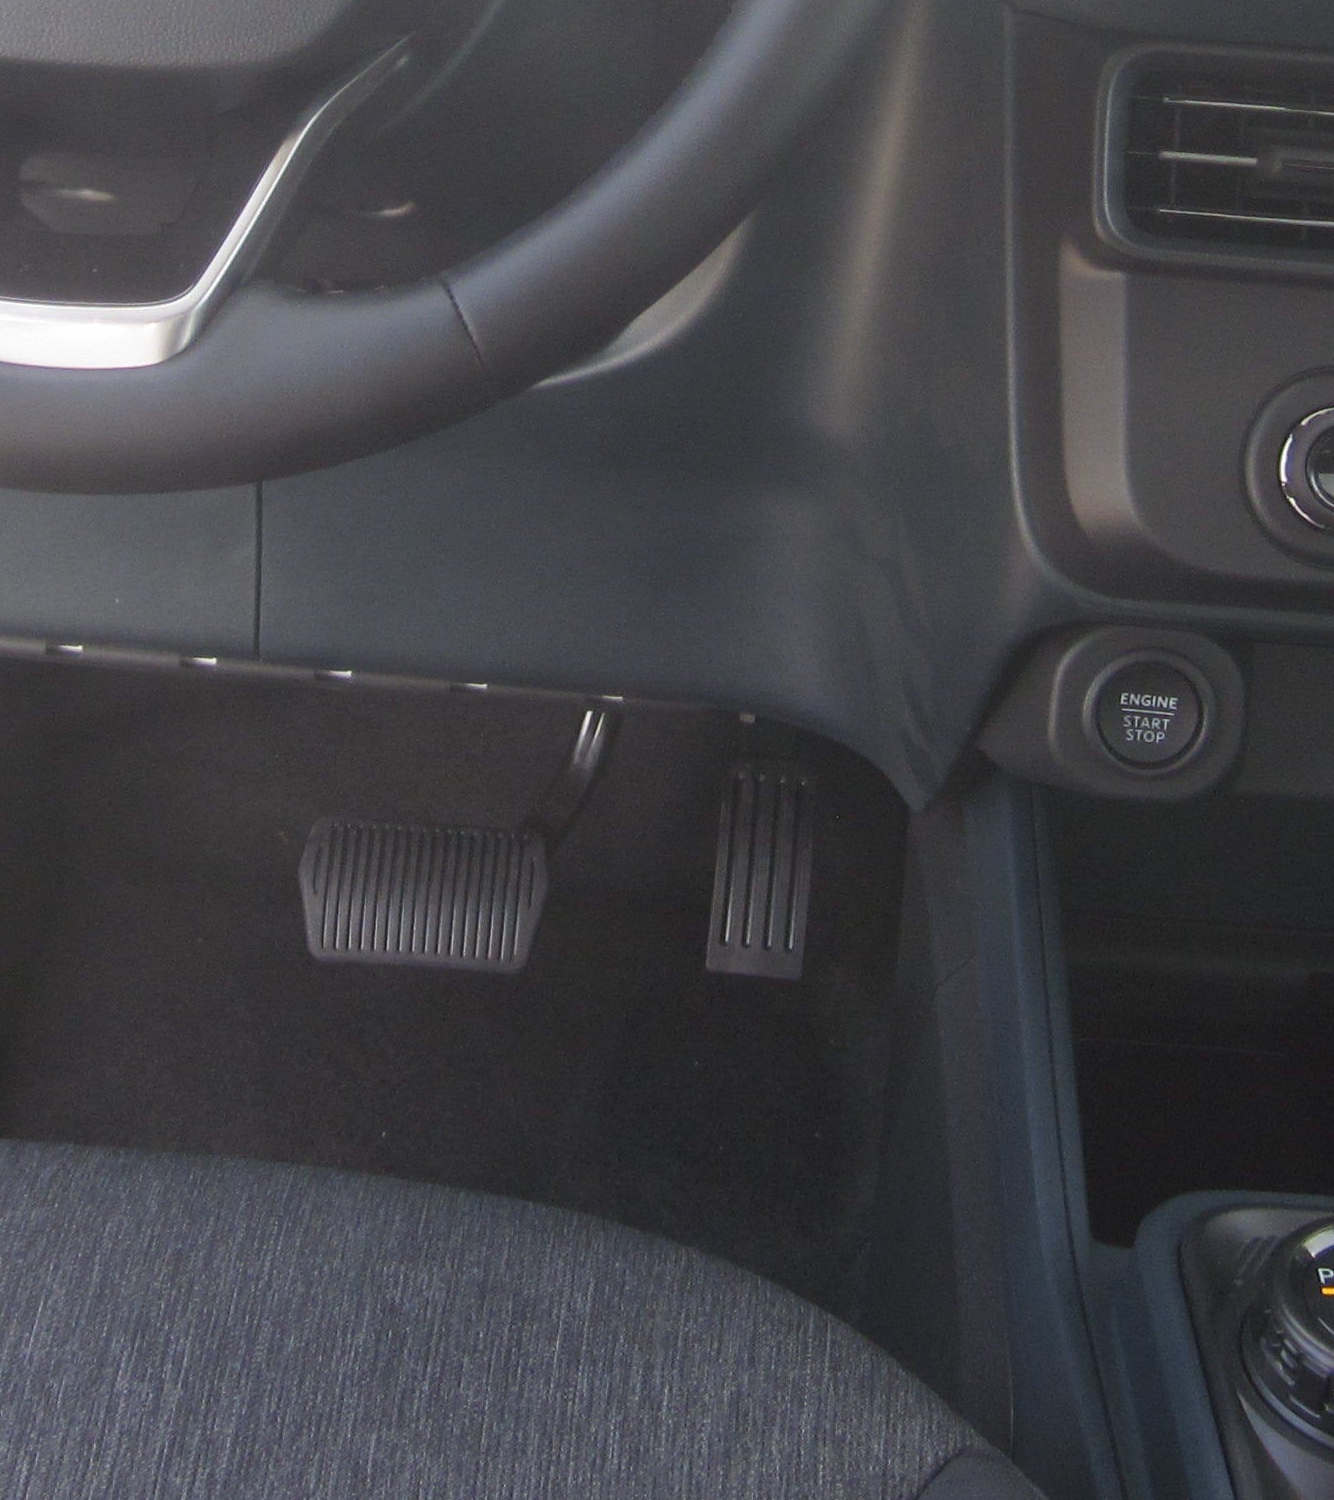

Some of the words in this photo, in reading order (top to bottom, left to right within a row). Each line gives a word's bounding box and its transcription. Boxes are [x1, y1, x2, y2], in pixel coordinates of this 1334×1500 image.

[1120, 692, 1178, 709] ENGINE
[1123, 715, 1170, 731] START
[1125, 728, 1166, 743] STOP
[1318, 1268, 1334, 1284] P
